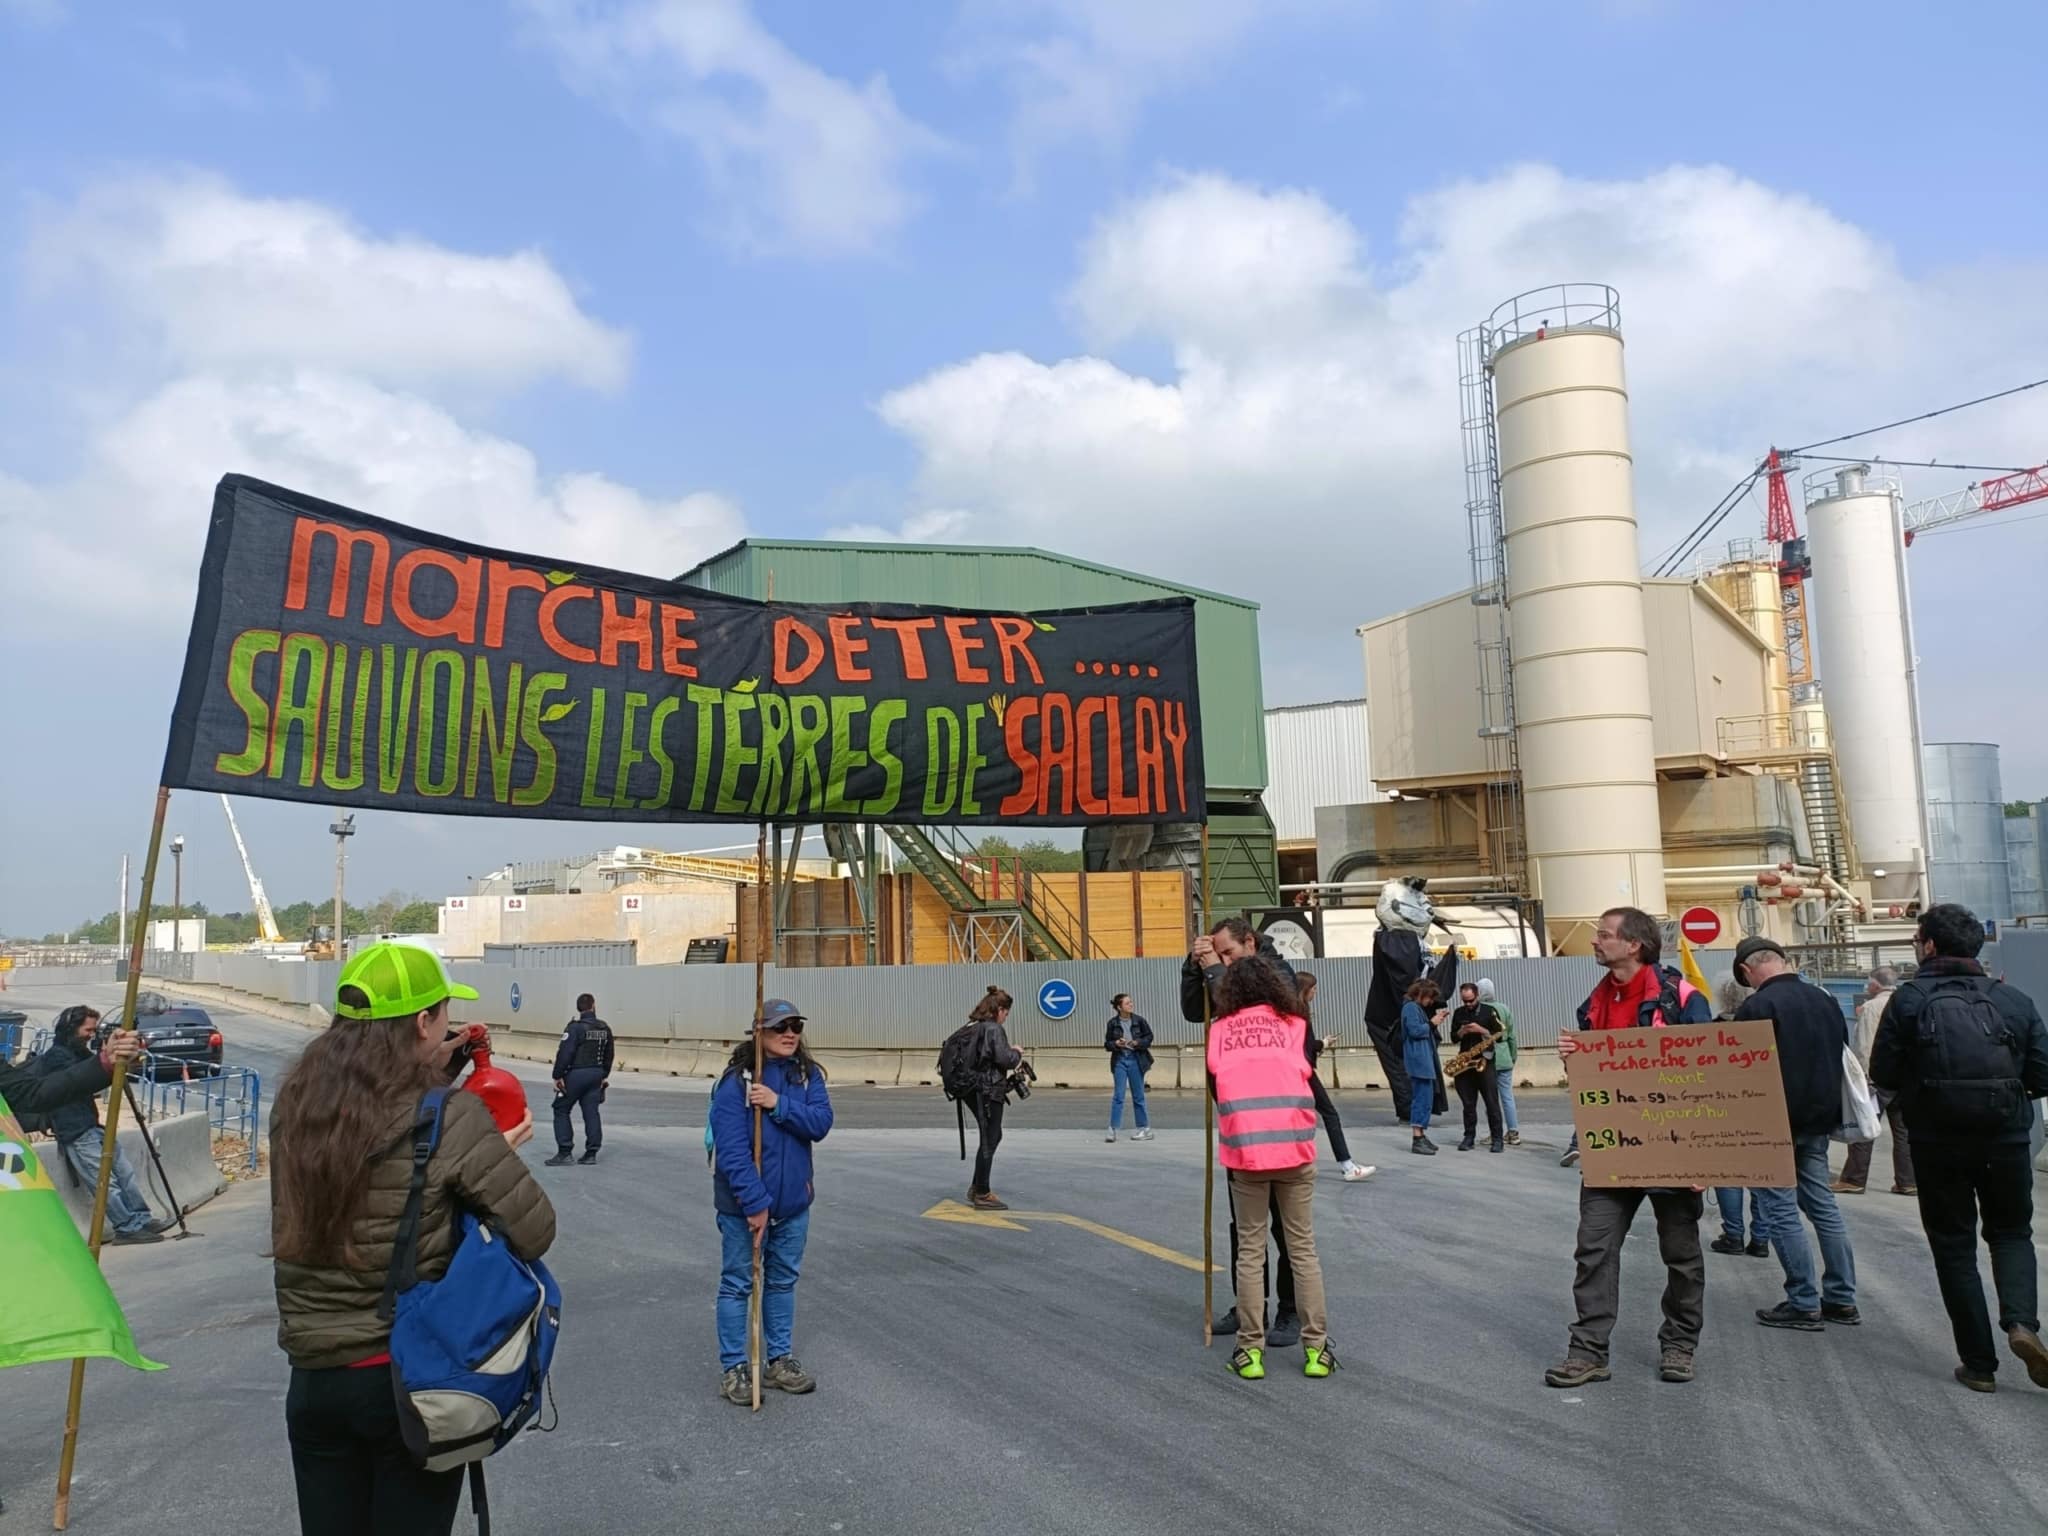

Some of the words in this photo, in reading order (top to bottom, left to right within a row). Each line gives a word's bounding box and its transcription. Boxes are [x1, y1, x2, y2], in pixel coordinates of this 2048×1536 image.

[216, 628, 568, 807] SAUVONS
[581, 687, 681, 810] LES
[922, 703, 987, 816] DE
[1000, 692, 1189, 816] SACLAY
[508, 900, 522, 908] C.3
[626, 899, 639, 909] C.2
[1227, 1016, 1280, 1031] SAUVONS
[1224, 1034, 1286, 1051] SACLAY
[1660, 1036, 1706, 1057] pour
[1718, 1030, 1744, 1046] la
[1599, 1053, 1689, 1072] recherche
[1697, 1055, 1718, 1065] en
[1728, 1049, 1769, 1068] agro
[1658, 1072, 1704, 1085] Avant
[1580, 1090, 1611, 1106] 153
[1616, 1088, 1638, 1103] ha
[1648, 1092, 1666, 1104] 59
[1641, 1104, 1728, 1125] Aujourd'hui
[1585, 1128, 1616, 1150] 28
[1618, 1129, 1643, 1147] ha
